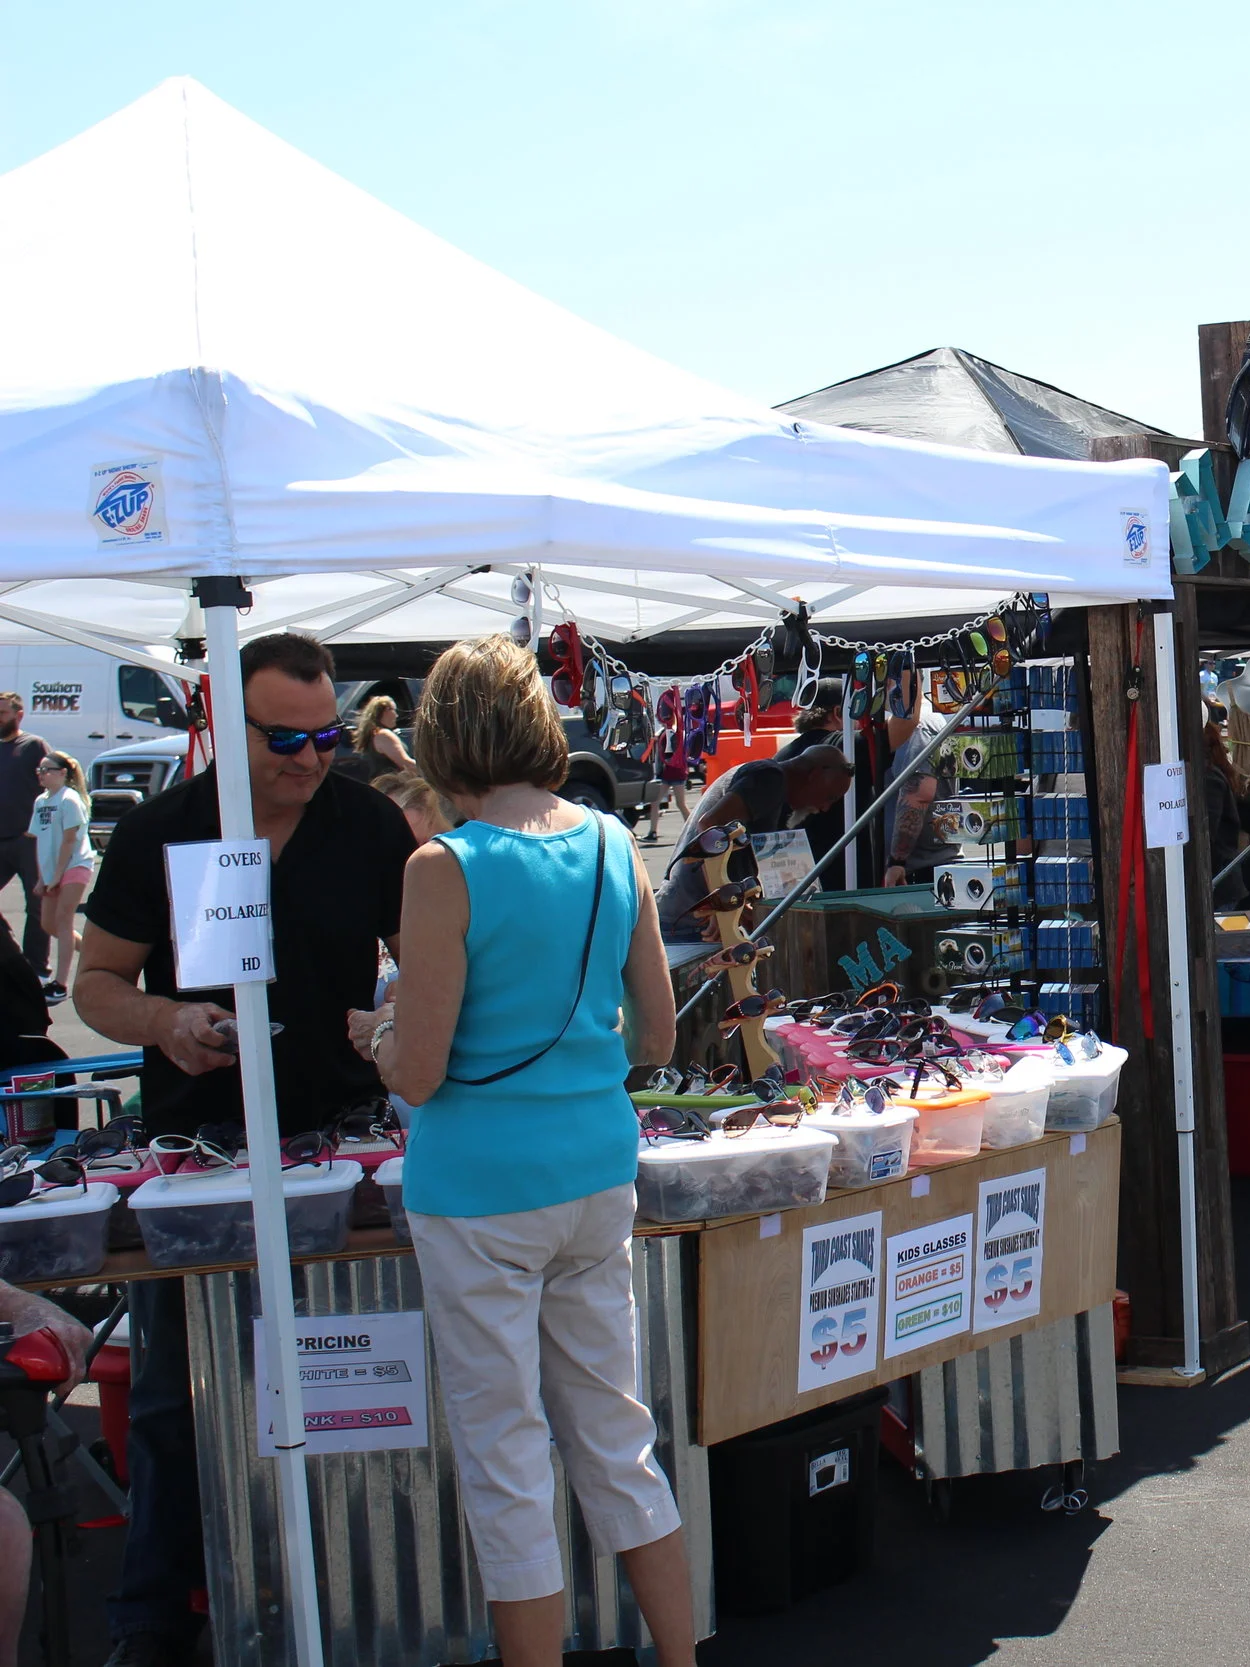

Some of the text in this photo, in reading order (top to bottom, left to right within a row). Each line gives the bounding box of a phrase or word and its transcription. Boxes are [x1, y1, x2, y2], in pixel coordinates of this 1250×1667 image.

[32, 681, 82, 693] Southern
[32, 694, 81, 711] PRIDE
[219, 852, 262, 867] OVERS
[205, 903, 269, 922] POLARIZE
[241, 957, 261, 971] HD
[837, 927, 912, 994] MA
[1002, 1187, 1021, 1218] COAST
[1021, 1182, 1040, 1225] SHADES
[811, 1227, 875, 1288] THIRD COAST SHADES
[898, 1232, 967, 1264] KIDS GLASSES
[869, 1276, 876, 1297] AT
[898, 1262, 962, 1292] ORANGE = $5
[984, 1256, 1032, 1313] $5
[898, 1300, 960, 1331] GREEN = $10
[810, 1308, 867, 1370] $5
[299, 1368, 349, 1381] HITE
[373, 1364, 399, 1378] $5
[304, 1414, 336, 1427] NK
[360, 1411, 399, 1424] $10
